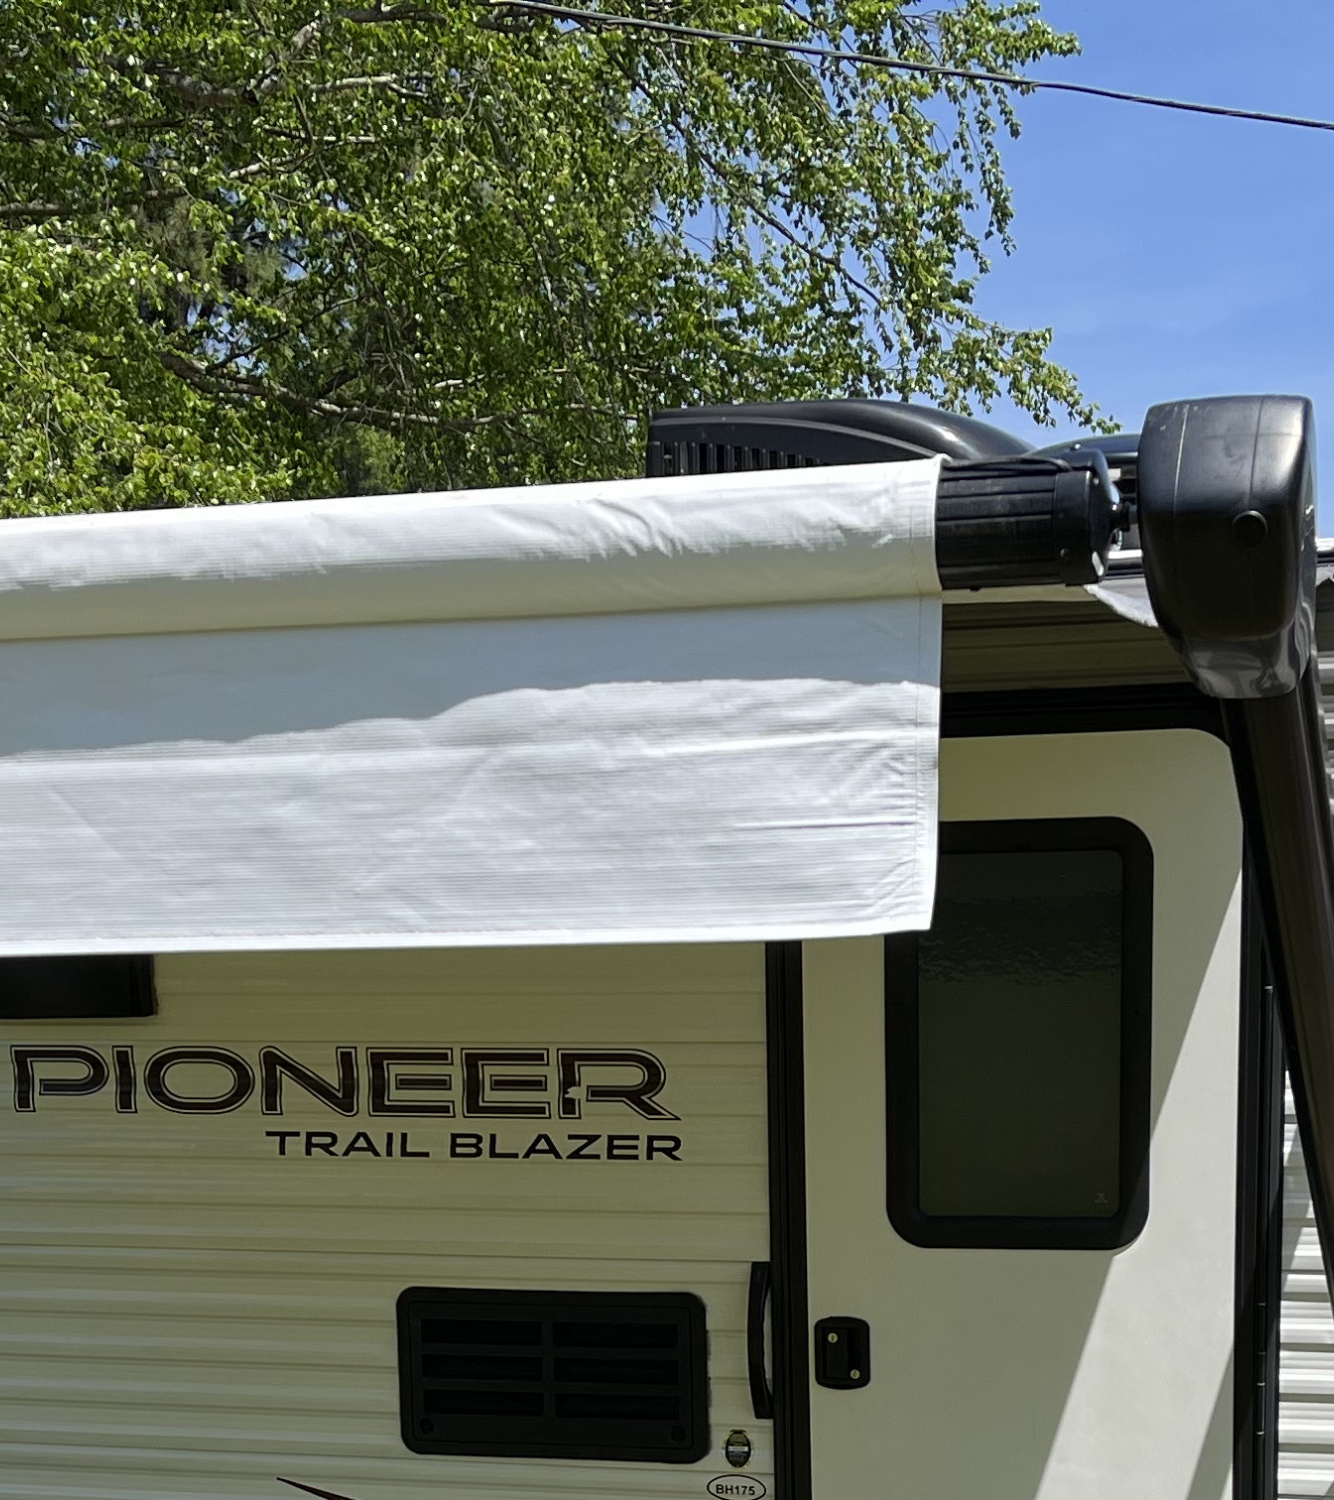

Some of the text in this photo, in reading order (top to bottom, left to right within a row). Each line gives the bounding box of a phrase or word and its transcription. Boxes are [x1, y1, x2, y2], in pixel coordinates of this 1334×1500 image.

[9, 1044, 682, 1121] PIONEER
[265, 1130, 683, 1161] TRAIL BLAZER
[715, 1483, 756, 1496] BH175
